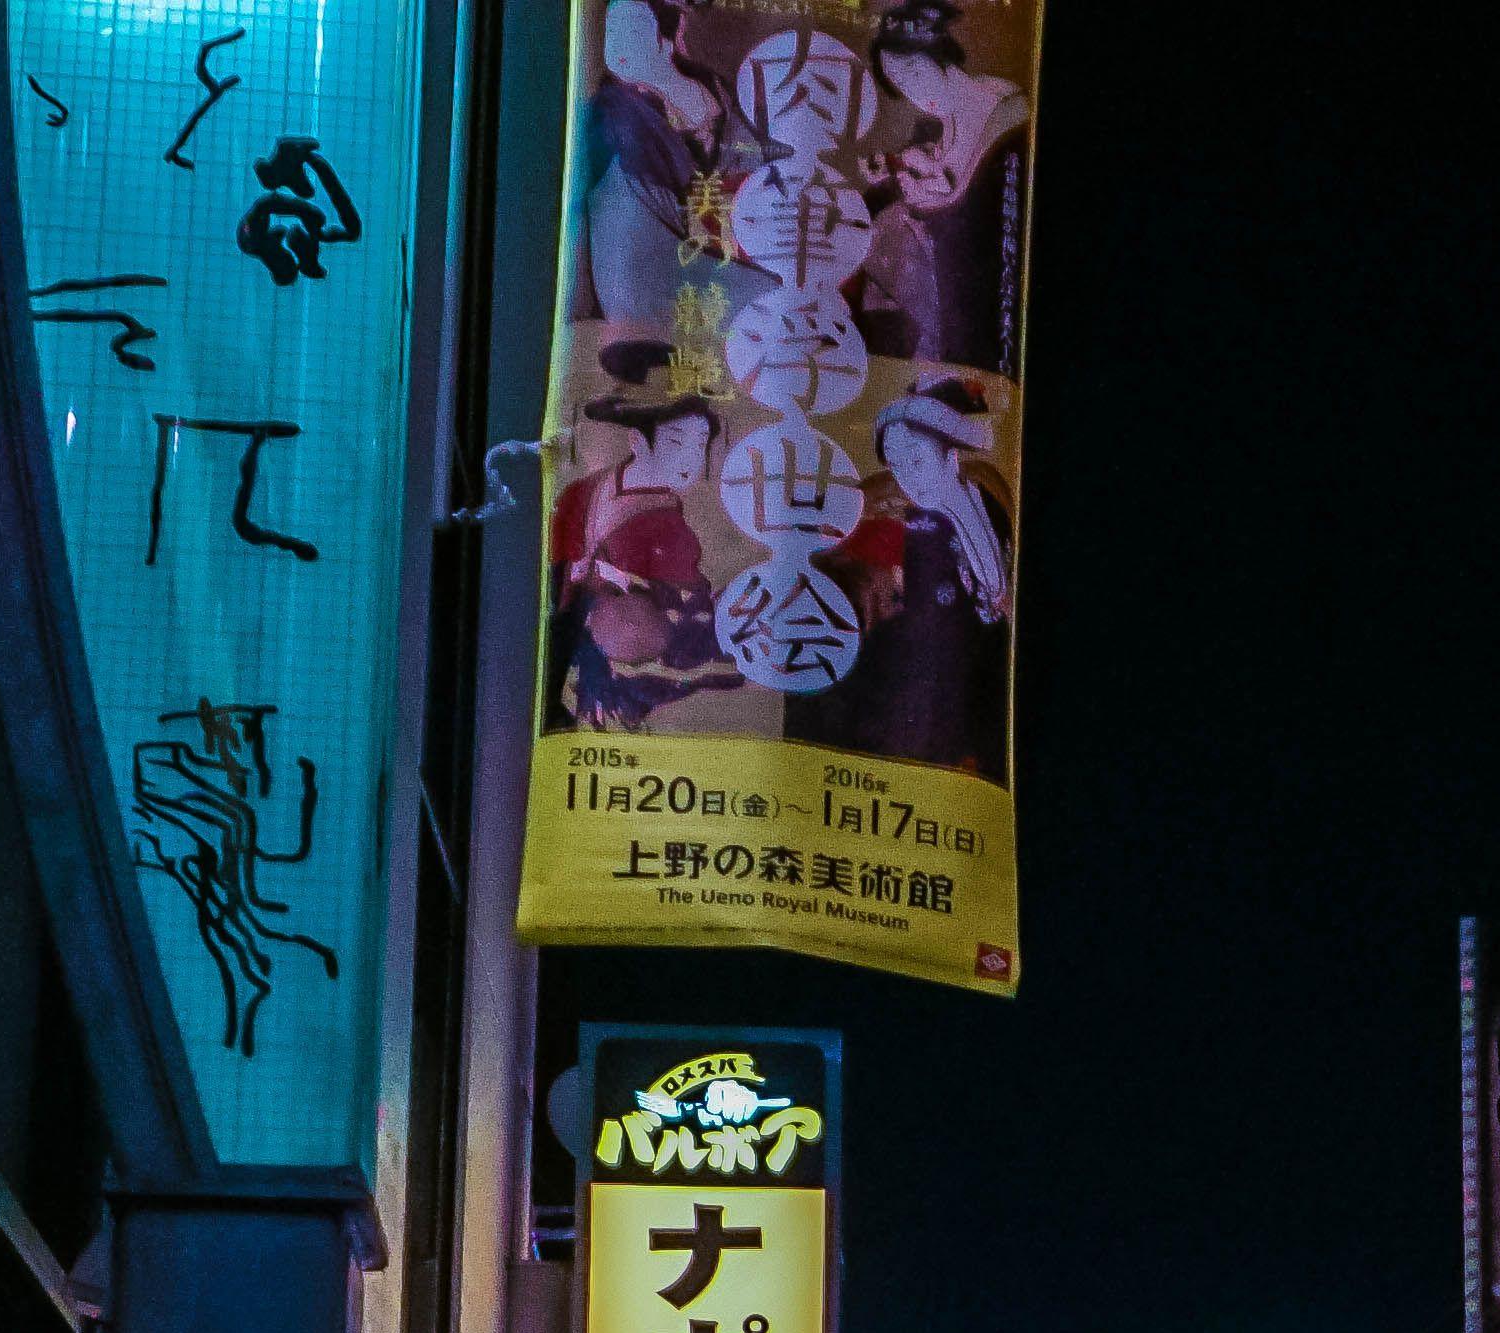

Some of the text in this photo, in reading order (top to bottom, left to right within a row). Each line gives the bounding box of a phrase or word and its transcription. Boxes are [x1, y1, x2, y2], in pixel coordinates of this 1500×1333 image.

[726, 24, 870, 680] 肉筆浮世絵
[568, 746, 640, 768] 2015年
[611, 839, 955, 915] 上野の森美術館
[657, 886, 911, 932] The Ueno Royal Museum
[659, 1057, 740, 1096] ロメスパ
[596, 1108, 825, 1178] バルボア
